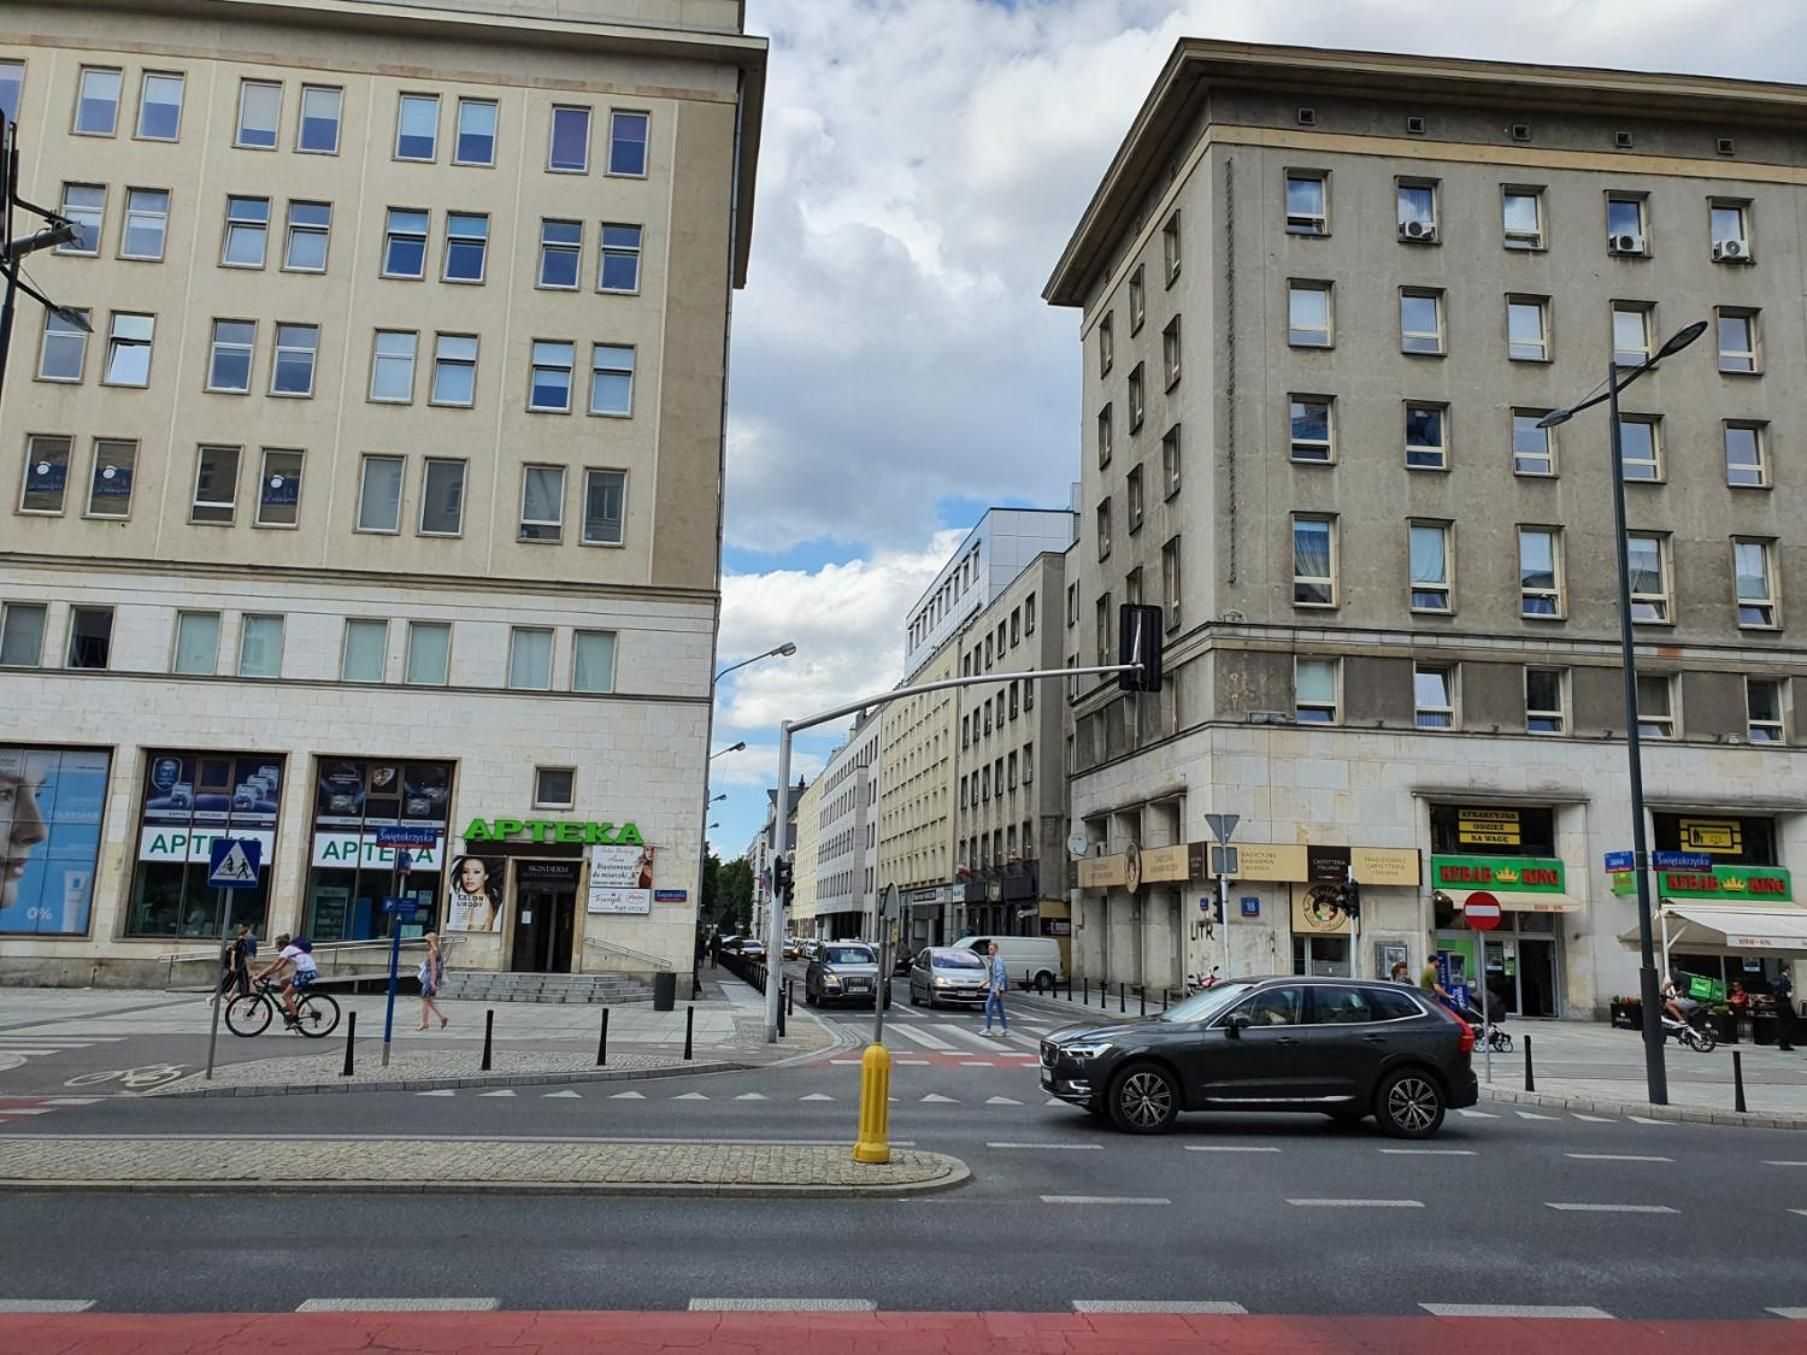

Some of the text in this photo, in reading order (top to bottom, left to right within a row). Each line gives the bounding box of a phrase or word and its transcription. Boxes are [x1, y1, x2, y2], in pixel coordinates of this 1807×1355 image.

[463, 818, 643, 844] APTEKA
[1440, 866, 1559, 885] KEBAB KING
[1666, 874, 1786, 894] KEBAB KING
